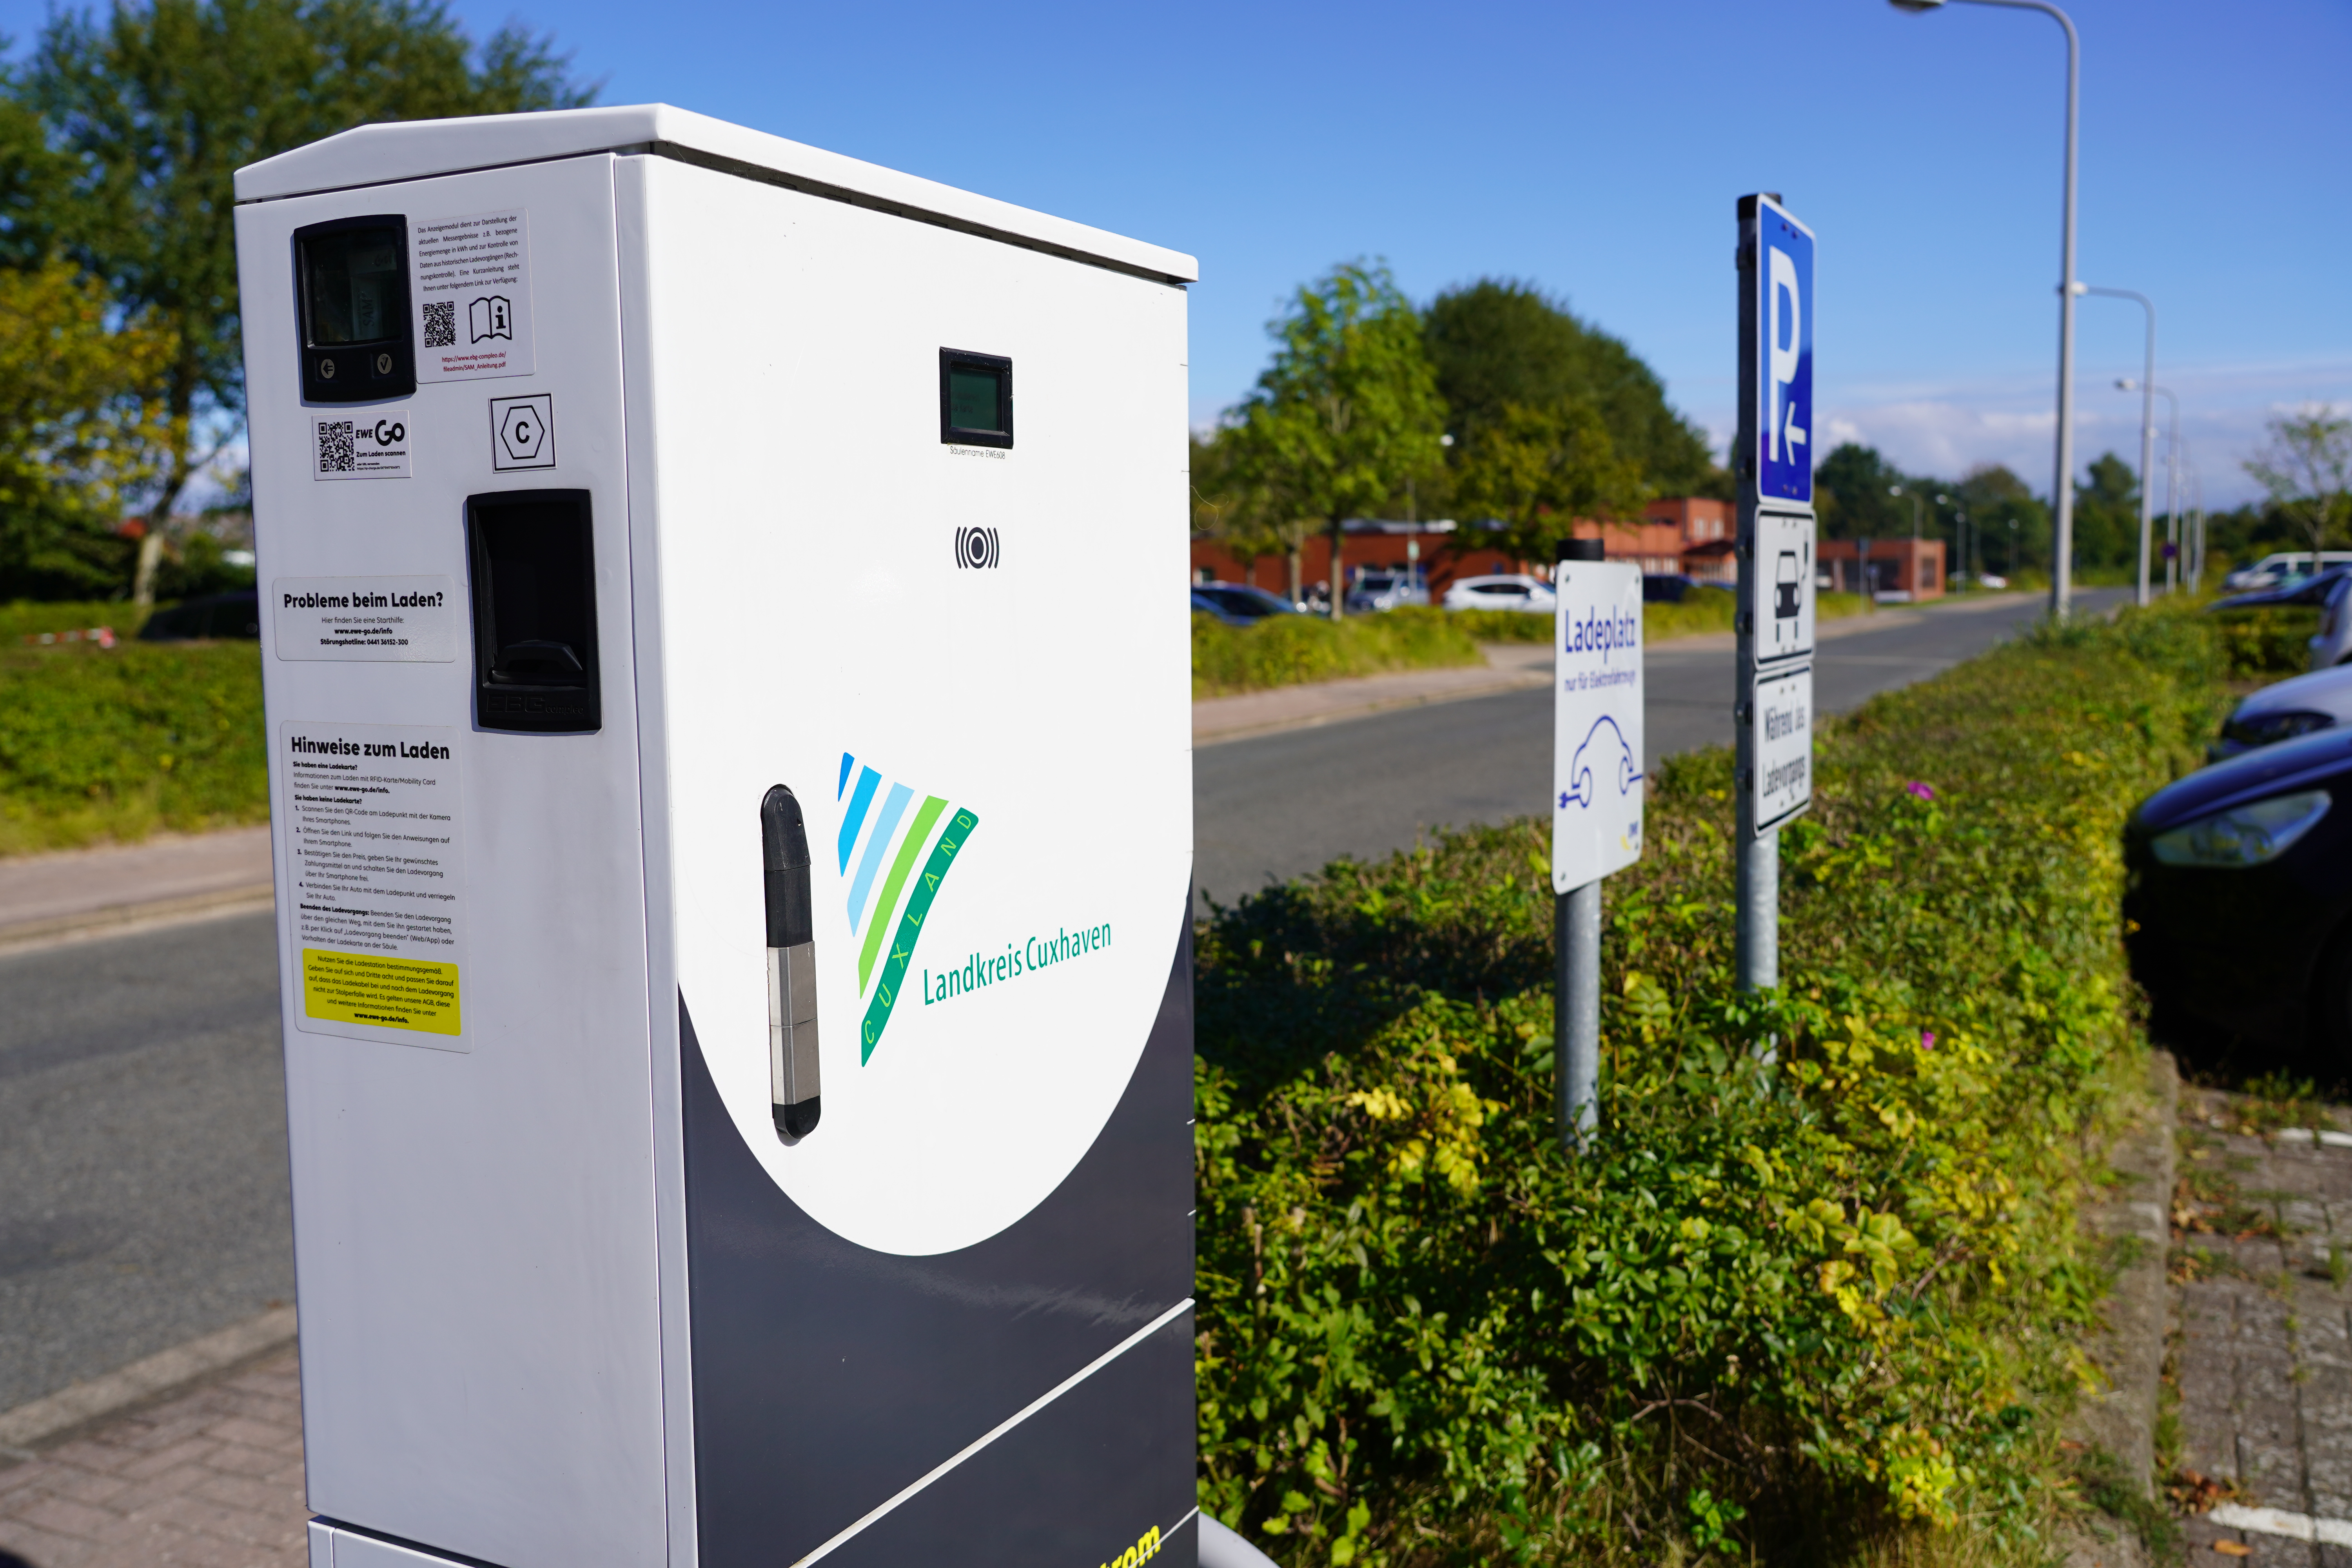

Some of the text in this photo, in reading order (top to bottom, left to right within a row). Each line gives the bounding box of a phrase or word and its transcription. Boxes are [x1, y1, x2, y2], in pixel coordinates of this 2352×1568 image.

[427, 222, 458, 232] Anzeigemodul
[443, 233, 478, 242] Messergebnisse
[419, 249, 450, 257] Energiemenge
[487, 240, 508, 249] Kontrolle
[442, 258, 468, 266] historischen
[469, 254, 503, 263] Ladevorgängen
[504, 251, 519, 260] (Rech-
[420, 270, 456, 281] nungskontrolle).
[449, 281, 474, 289] folgendem
[442, 351, 506, 363] https://www.ebg-compleo.de/
[1769, 245, 1801, 462] P
[443, 361, 506, 372] fileadmin/SAM_Anleitung.pdf
[356, 429, 373, 439] EWE
[515, 421, 530, 444] C
[950, 446, 1005, 459] Säulenname EWE608
[284, 591, 443, 608] Probleme beim Laden?
[334, 628, 392, 636] www.ewe-go.de/info
[1565, 605, 1635, 664] Ladeplatz
[320, 638, 366, 646] Störungshotline:
[486, 694, 584, 716] EBG compleo
[291, 736, 449, 759] Hinweise zum Laden
[370, 776, 421, 786] RFID-Karte/Mobility
[379, 810, 407, 818] Ladepunkt
[332, 906, 369, 916] Ladevorgangs:
[416, 914, 451, 924] Ladevorgang
[865, 815, 972, 1045] CUXLAND
[354, 960, 385, 968] Ladestation
[387, 963, 442, 975] bestimmungsgemäß.
[924, 923, 1111, 1005] Landkreis Cuxhaven
[336, 988, 365, 998] Stolperfalle
[342, 979, 369, 987] Ladekabel
[418, 987, 454, 999] Ladevorgang
[358, 1002, 394, 1011] Informationen
[354, 1013, 409, 1024] www.ewe-go.de/info.
